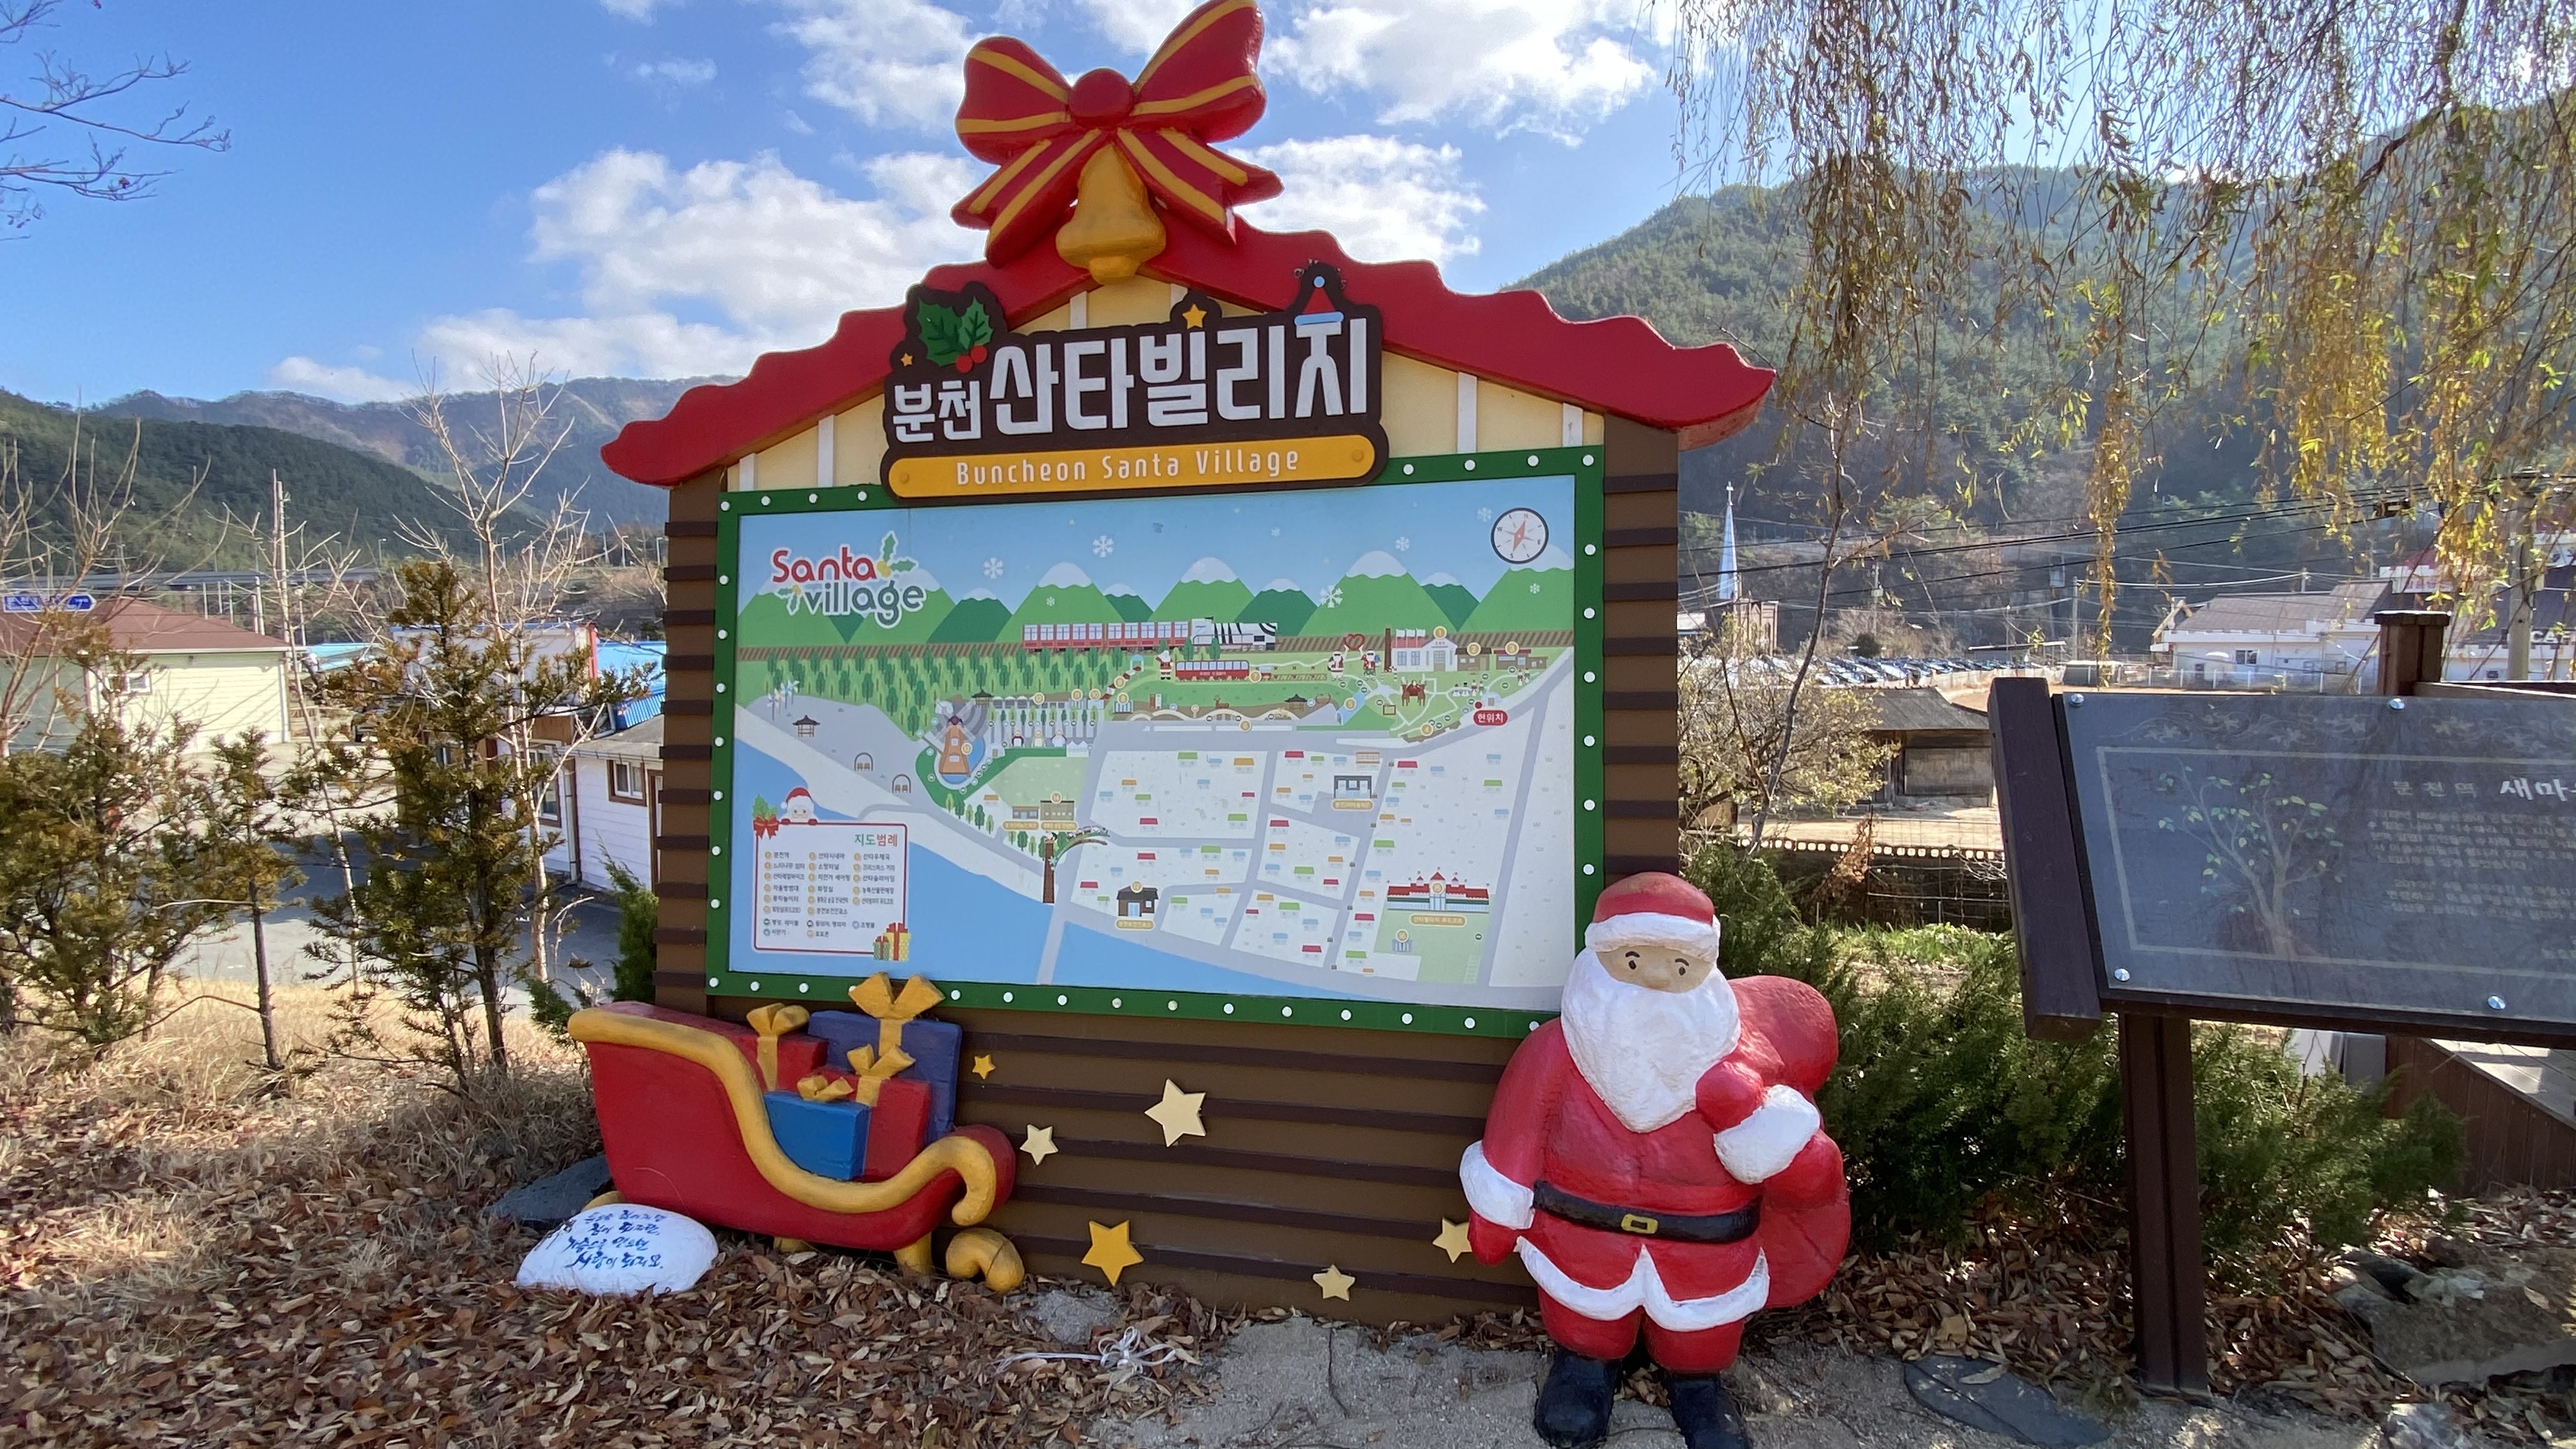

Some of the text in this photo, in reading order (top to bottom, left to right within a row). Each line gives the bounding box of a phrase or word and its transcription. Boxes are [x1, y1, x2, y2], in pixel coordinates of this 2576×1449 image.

[893, 318, 1368, 443] 분천 산타빌리지
[956, 449, 1300, 486] Buncheon Santa Village
[772, 547, 877, 583] Santa
[804, 579, 924, 626] village
[1477, 712, 1504, 723] 현위치
[2500, 776, 2576, 802] 새마
[854, 833, 898, 847] 지도범례
